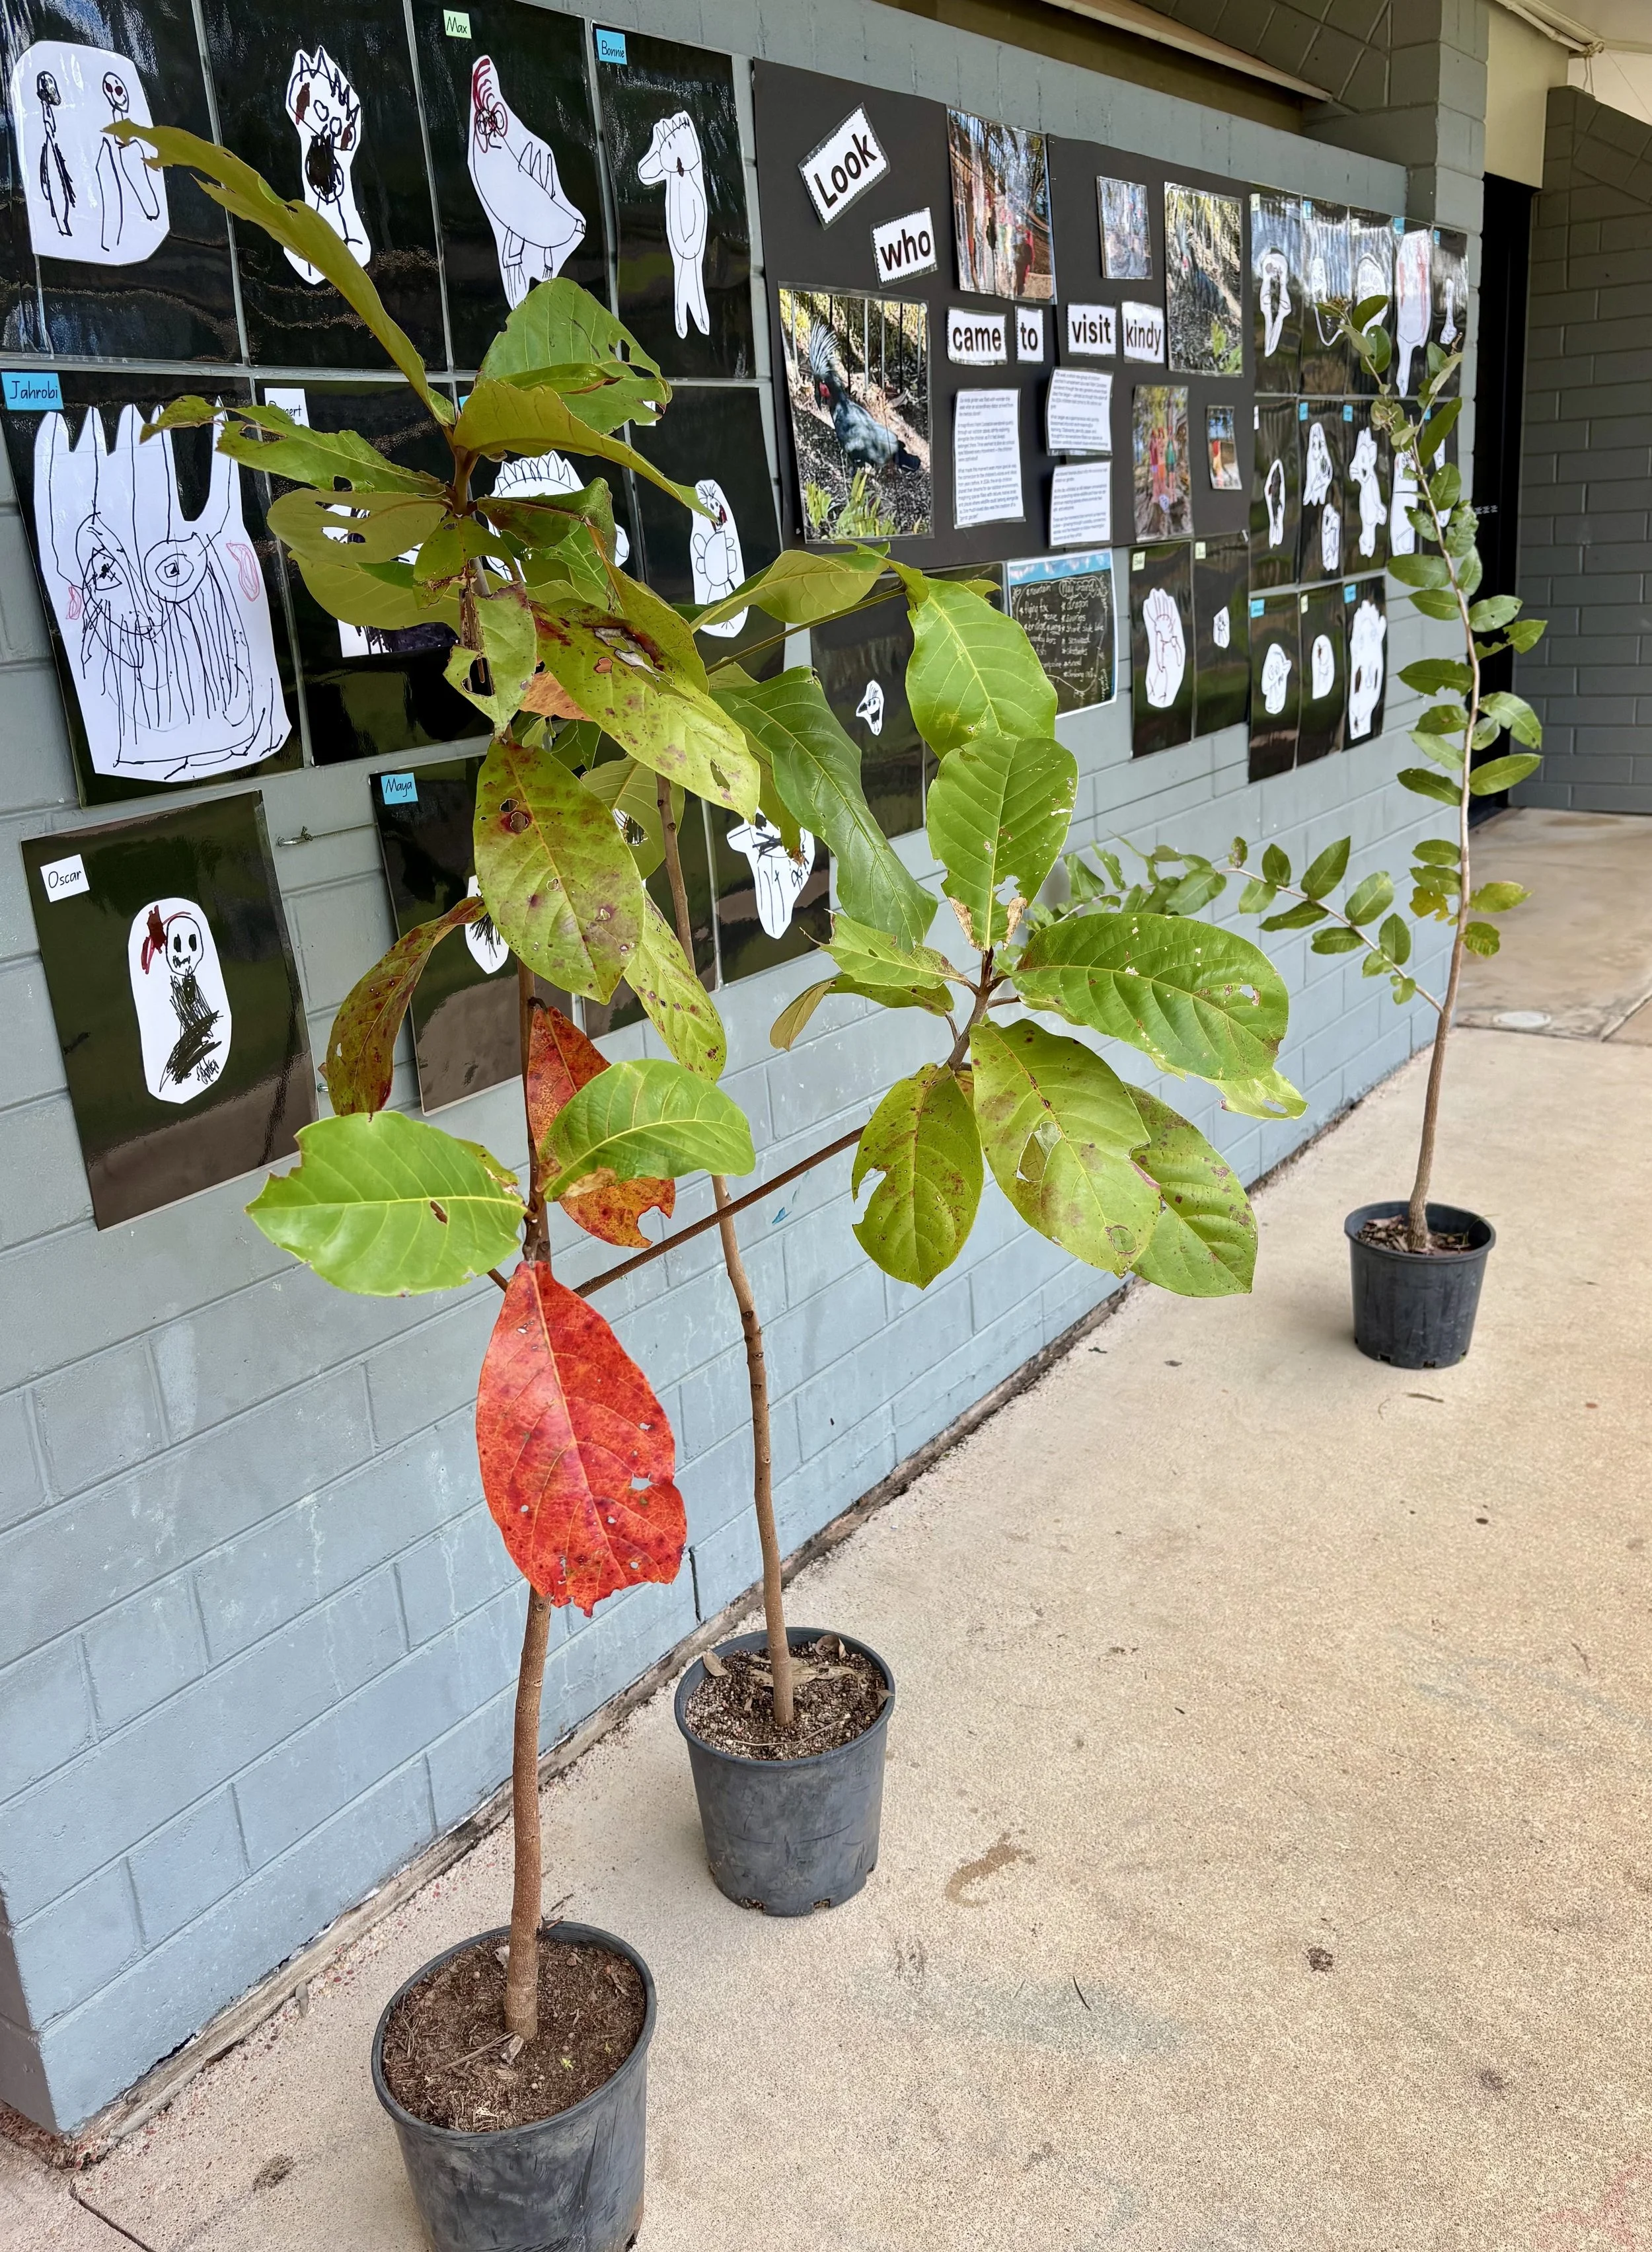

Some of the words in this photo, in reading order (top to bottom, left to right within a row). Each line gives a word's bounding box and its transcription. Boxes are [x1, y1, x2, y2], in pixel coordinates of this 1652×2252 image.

[446, 16, 468, 34] Max
[601, 40, 624, 58] Bonnie
[813, 134, 878, 210] Look
[880, 229, 931, 272] who
[952, 327, 1002, 352] came
[1020, 321, 1039, 352] to
[1072, 317, 1111, 344] visit
[1125, 321, 1162, 356] kindy
[10, 380, 58, 399] Jahrobi
[385, 777, 412, 798] Maya
[48, 871, 82, 888] Oscar
